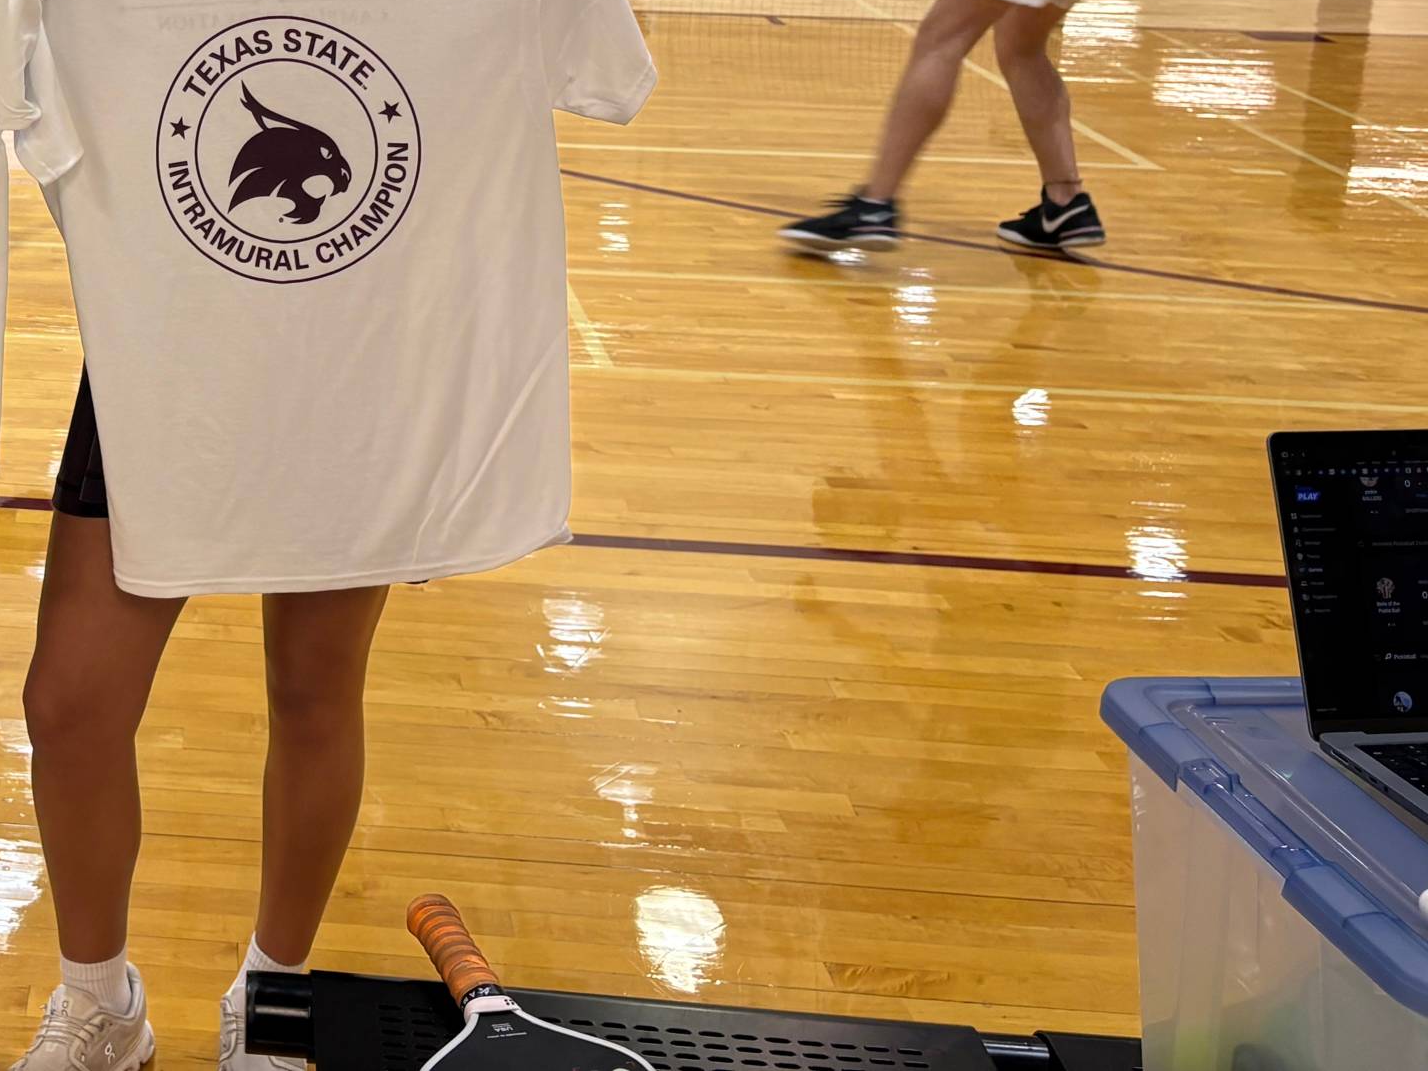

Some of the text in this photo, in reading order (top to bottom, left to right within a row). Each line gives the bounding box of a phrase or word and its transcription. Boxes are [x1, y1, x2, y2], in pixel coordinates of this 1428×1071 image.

[182, 28, 376, 98] TEXAS STATE
[167, 141, 410, 272] INTRAMURAL CHAMPION
[1296, 491, 1320, 502] PLAY
